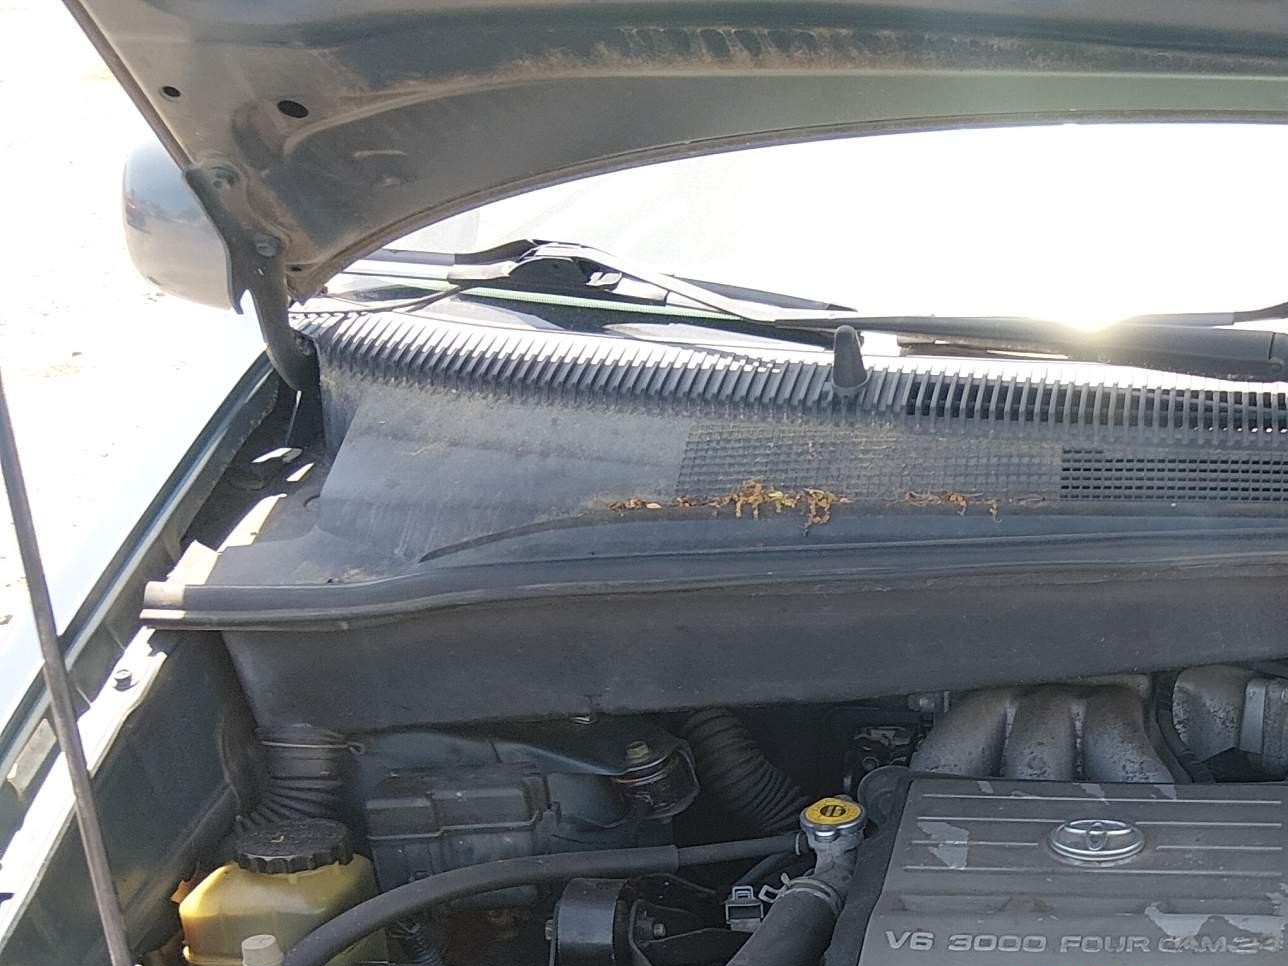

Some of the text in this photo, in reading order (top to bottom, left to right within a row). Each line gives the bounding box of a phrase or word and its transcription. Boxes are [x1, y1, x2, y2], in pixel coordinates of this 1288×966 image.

[884, 930, 935, 952] V6
[946, 934, 1047, 954] 3000
[1059, 935, 1152, 954] FOUR
[1157, 935, 1228, 954] CAM
